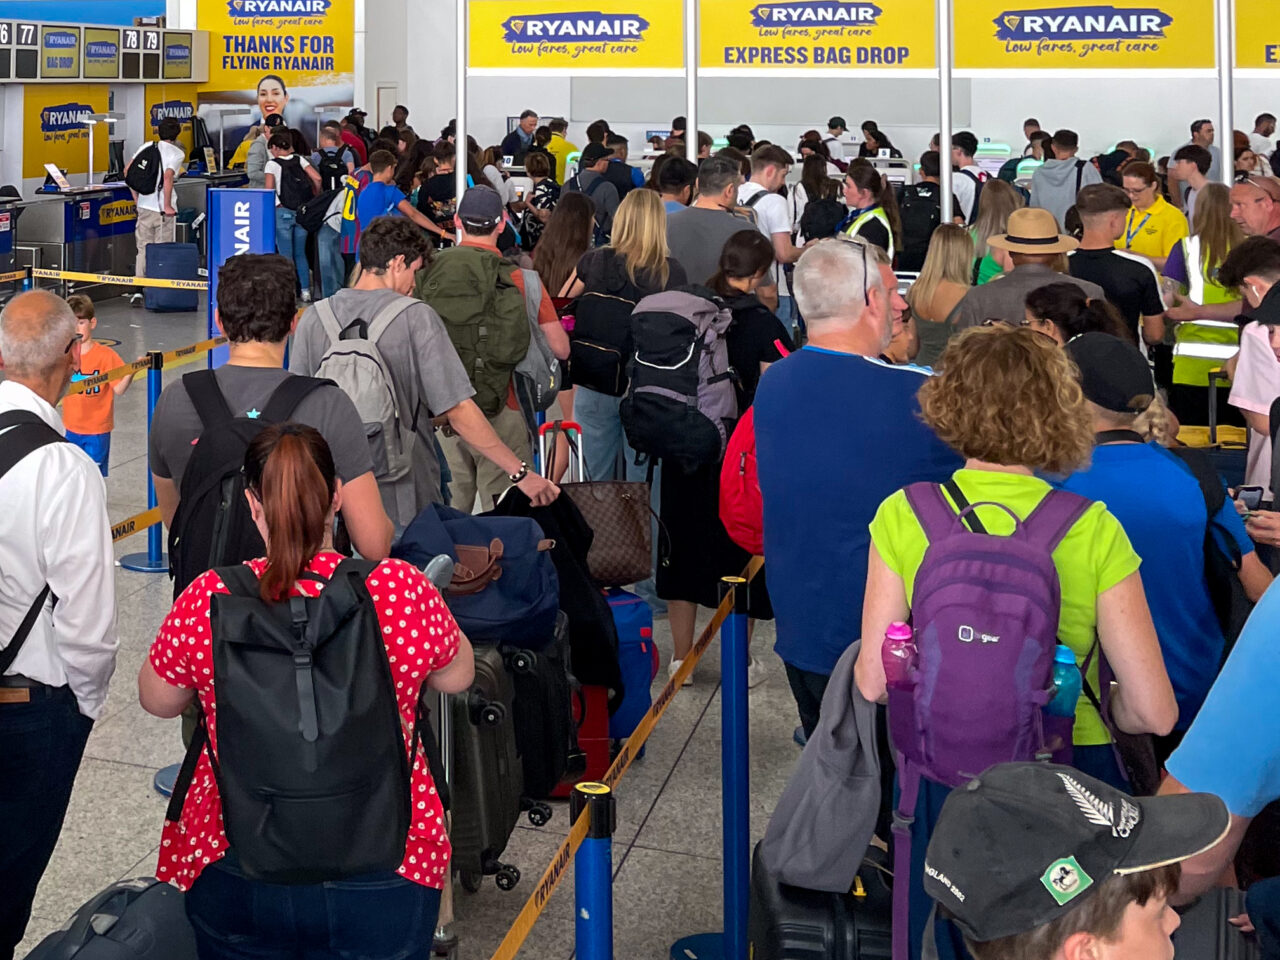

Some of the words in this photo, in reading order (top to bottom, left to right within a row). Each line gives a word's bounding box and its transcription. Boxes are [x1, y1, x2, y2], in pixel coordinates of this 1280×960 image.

[244, 0, 325, 13] RYANAIR
[773, 6, 875, 22] RYANAIR
[233, 17, 250, 26] Low
[276, 17, 303, 29] great
[527, 19, 640, 37] RYANAIR
[1023, 15, 1162, 33] RYANAIR
[21, 25, 35, 44] 77
[49, 36, 76, 45] RYANAIR
[126, 31, 138, 48] 78
[146, 31, 158, 49] 79
[758, 26, 779, 38] Low
[780, 26, 811, 39] fares,
[812, 26, 845, 41] great
[846, 28, 873, 37] care
[222, 35, 295, 54] THANKS
[299, 35, 335, 54] FOR
[511, 41, 535, 55] Low
[537, 41, 571, 57] fares,
[572, 41, 608, 58] great
[610, 43, 639, 54] care
[1004, 39, 1031, 53] Low
[1035, 37, 1077, 56] fares,
[1078, 39, 1123, 57] great
[1125, 42, 1160, 52] care
[222, 55, 270, 70] FLYING
[273, 56, 335, 71] RYANAIR
[723, 46, 809, 65] EXPRESS
[813, 46, 852, 65] BAG
[856, 46, 910, 65] DROP
[234, 201, 251, 256] NAIR
[539, 841, 571, 909] RYANAIR
